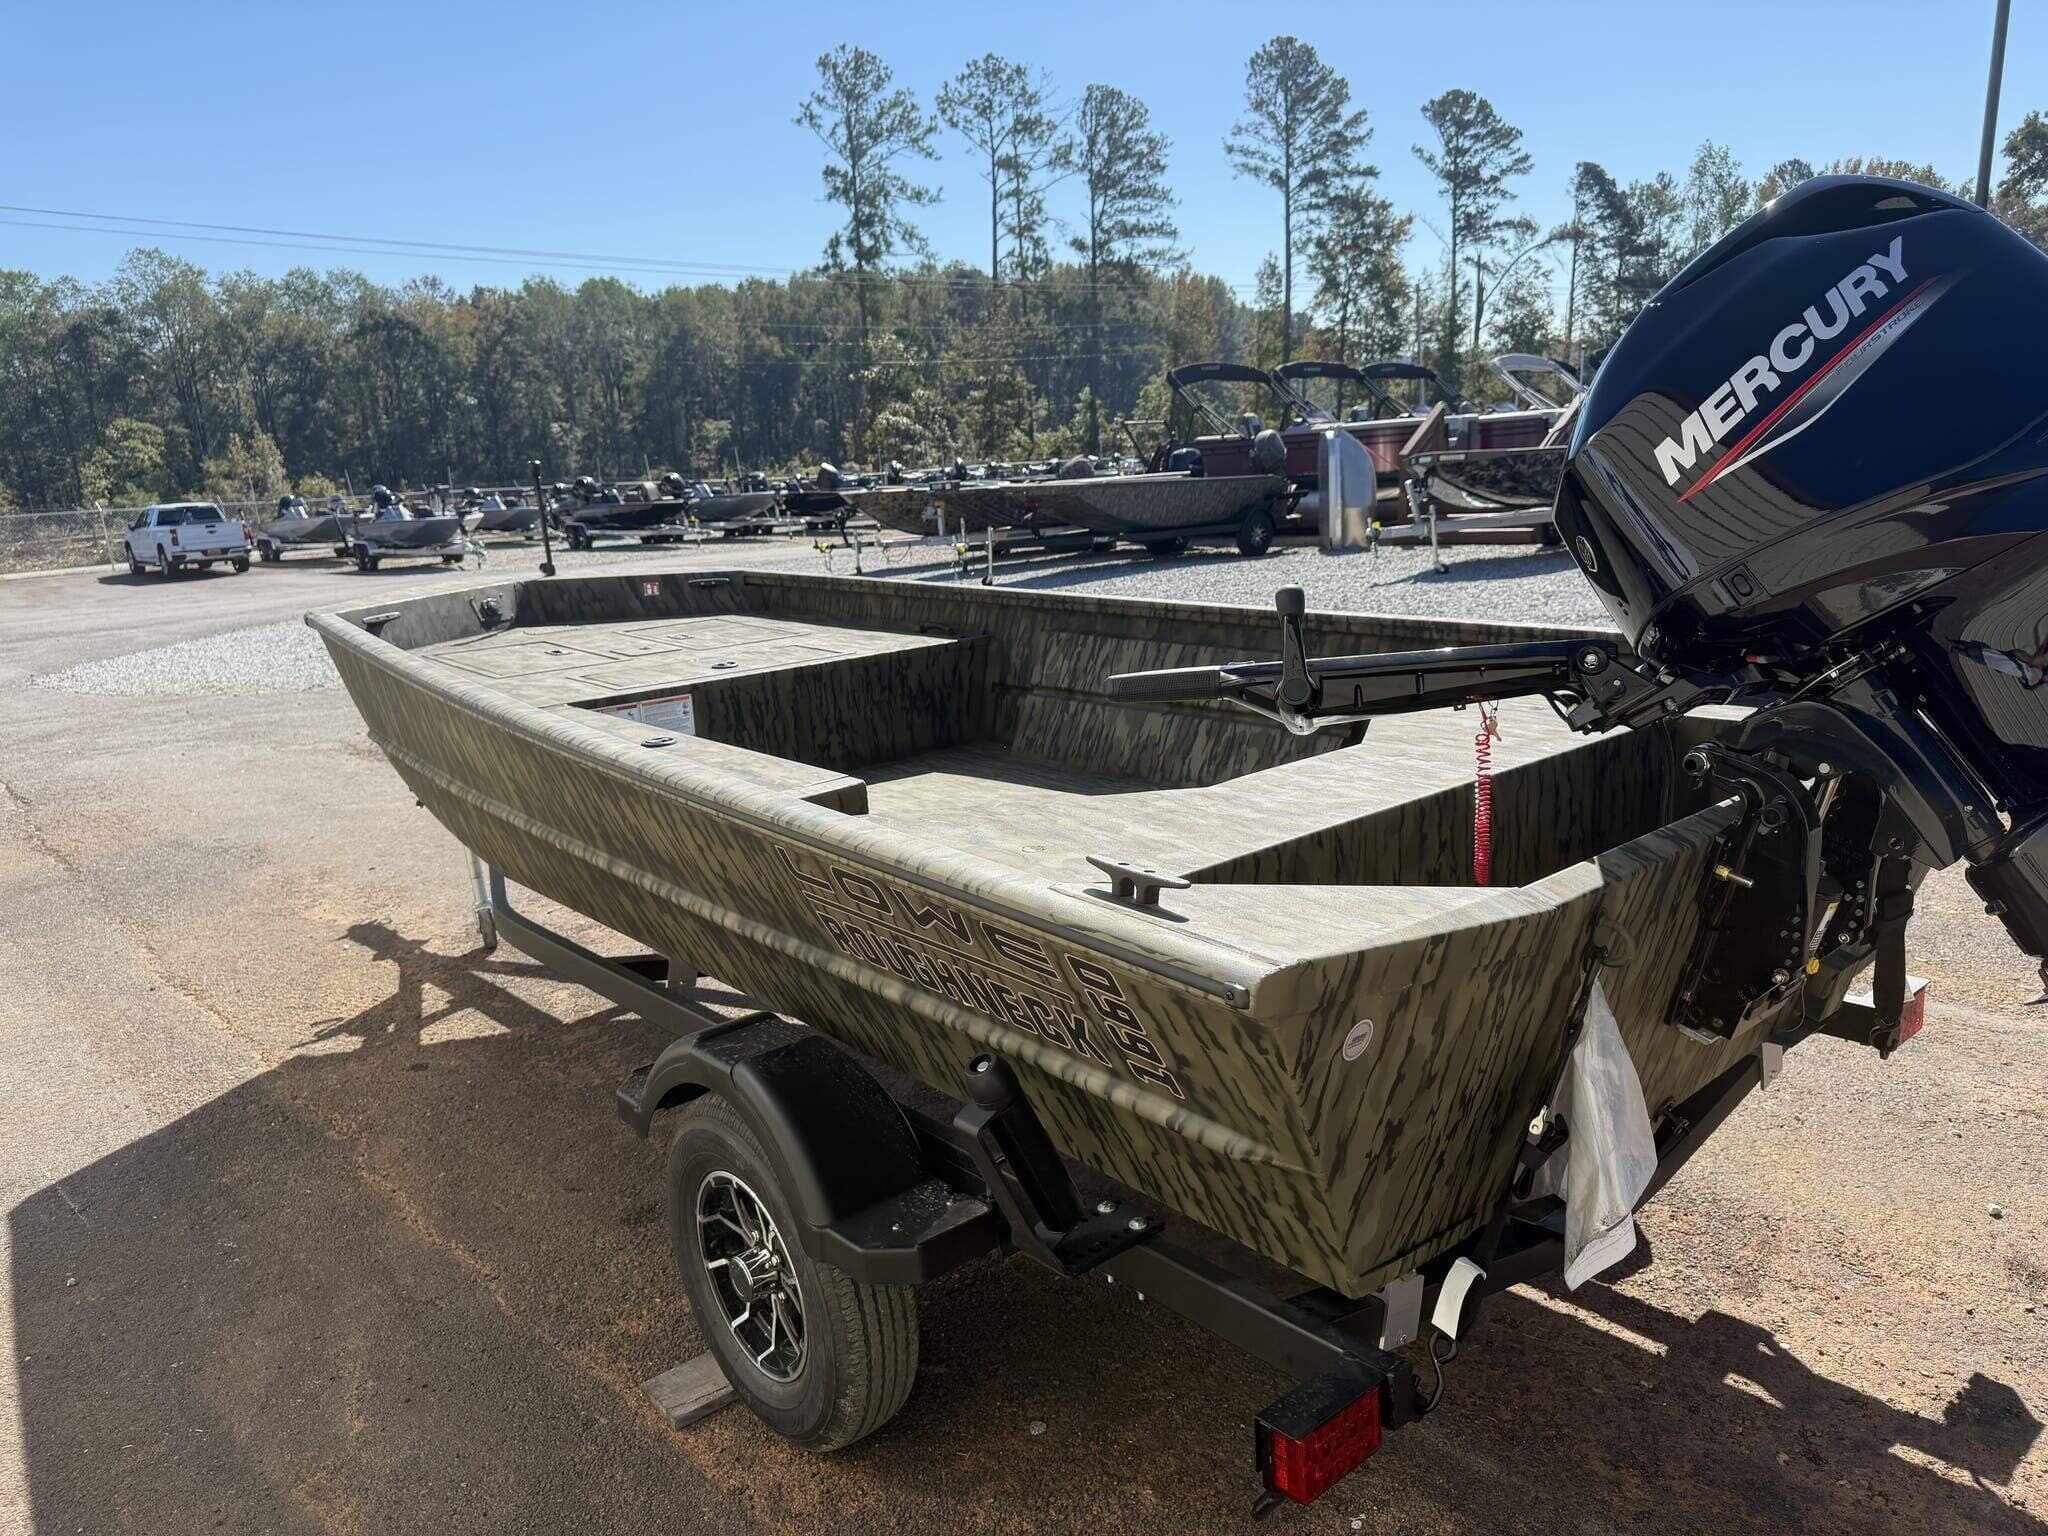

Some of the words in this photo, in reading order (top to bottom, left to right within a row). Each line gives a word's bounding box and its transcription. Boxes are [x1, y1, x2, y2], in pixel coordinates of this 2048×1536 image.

[1654, 236, 1908, 485] MERCURY
[775, 845, 1061, 982] LOWE
[816, 911, 1111, 1067] ROUGHNECK
[1065, 953, 1185, 1100] 1660
